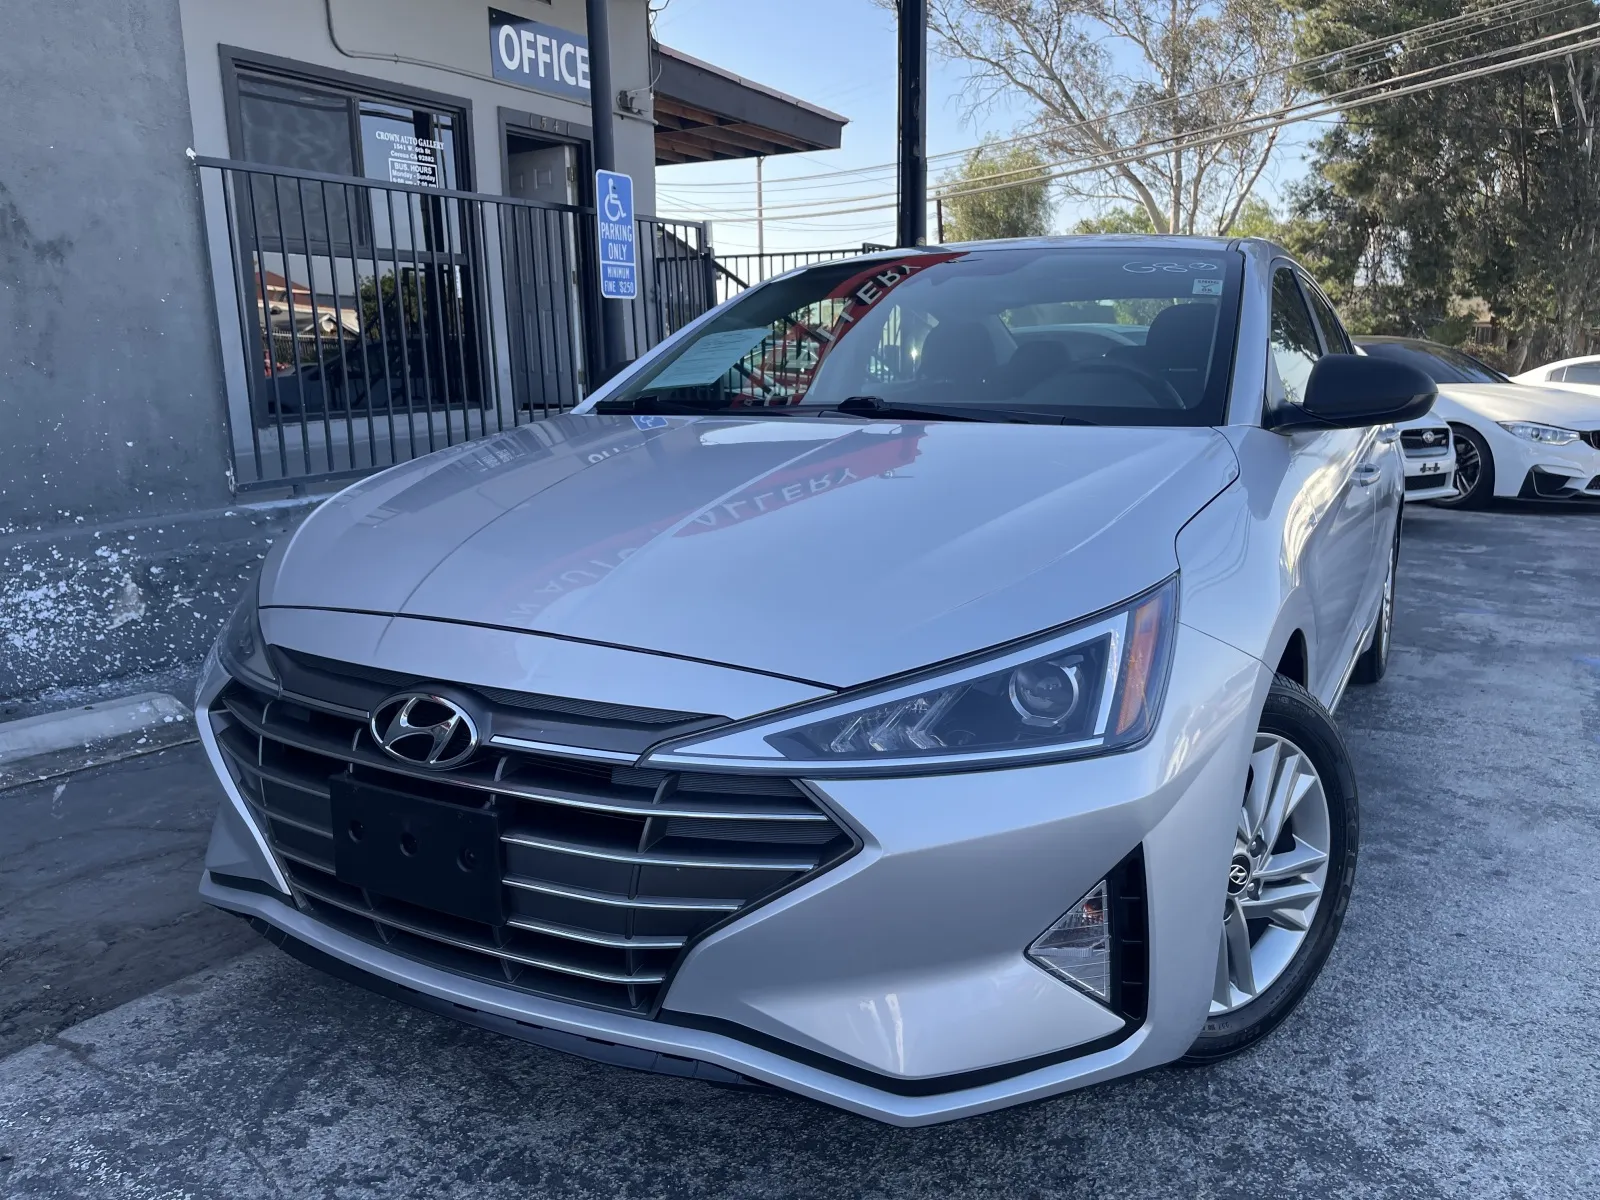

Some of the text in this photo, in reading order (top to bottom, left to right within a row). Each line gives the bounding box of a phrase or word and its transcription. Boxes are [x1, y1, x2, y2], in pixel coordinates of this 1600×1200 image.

[499, 24, 591, 90] OFFICE
[375, 130, 445, 150] CROWN AUTO GALLERY
[393, 143, 406, 151] 1541
[394, 162, 433, 174] BUS. HOURS
[392, 169, 413, 180] Monday
[417, 173, 436, 183] Sunday
[601, 222, 632, 242] PARKING
[608, 243, 627, 260] ONLY
[607, 267, 629, 279] MINIMUM
[604, 280, 634, 293] FINE $250
